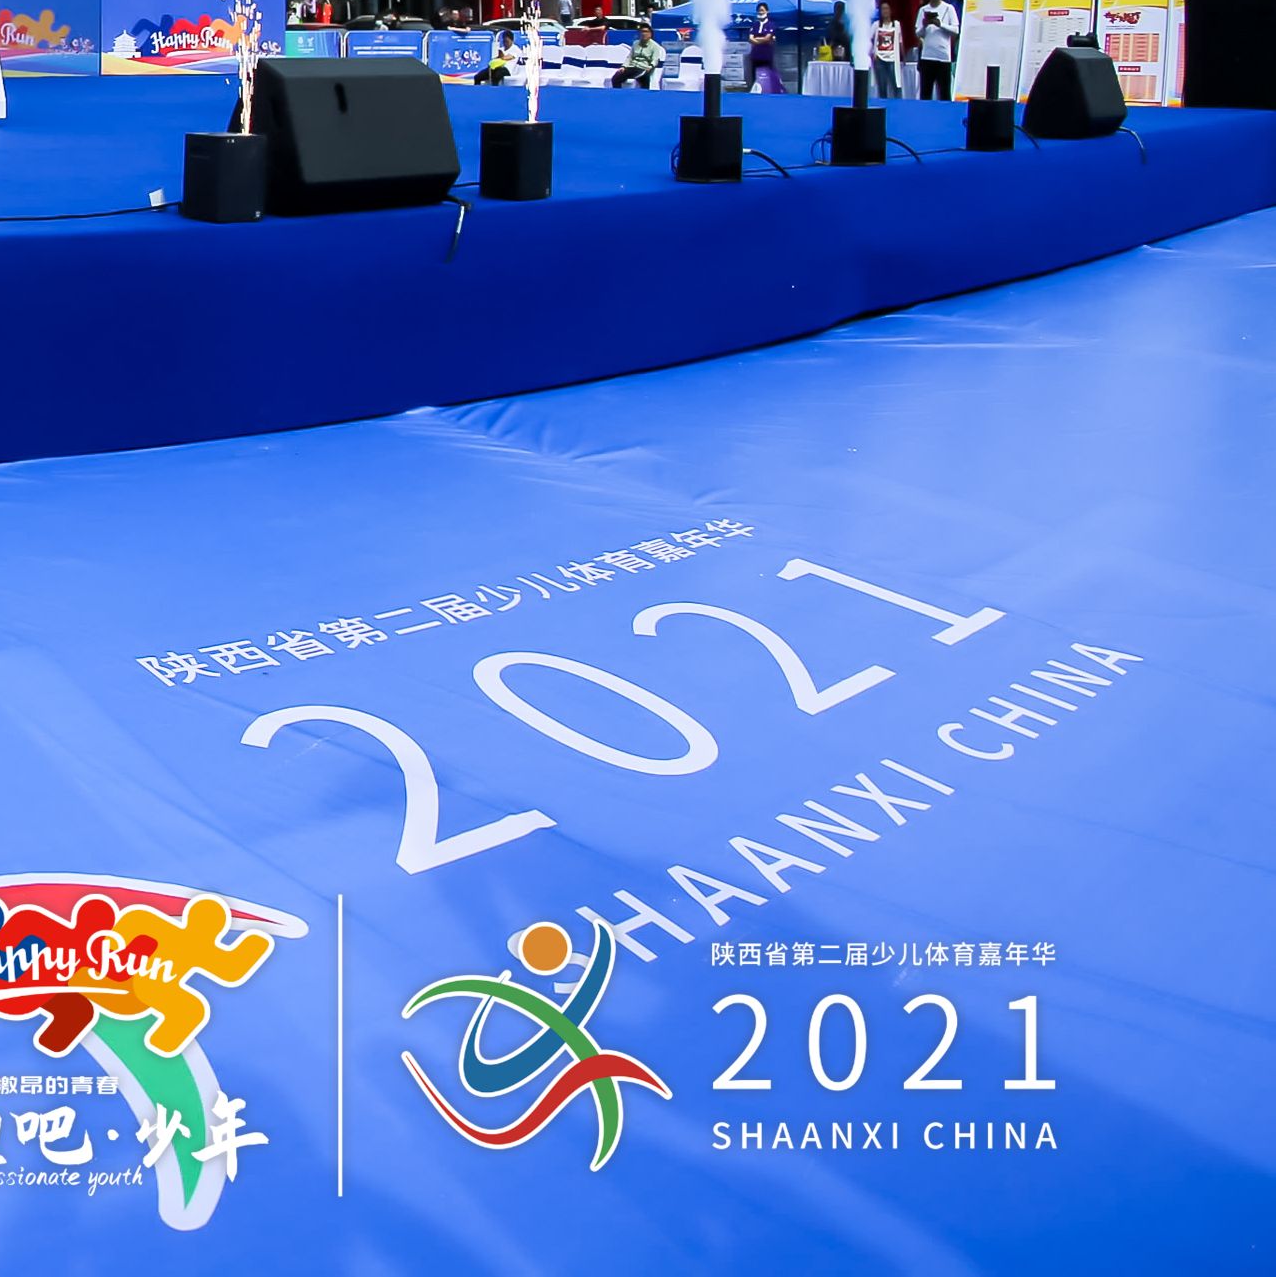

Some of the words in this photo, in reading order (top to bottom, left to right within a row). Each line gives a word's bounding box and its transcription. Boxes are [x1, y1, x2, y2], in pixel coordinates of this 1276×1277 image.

[0, 22, 35, 47] Run
[150, 31, 201, 55] Happy
[199, 26, 234, 50] Run
[135, 516, 758, 688] 陕西省第二届少儿体育嘉年华
[241, 557, 1008, 874] 2021
[937, 642, 1145, 761] CHINA
